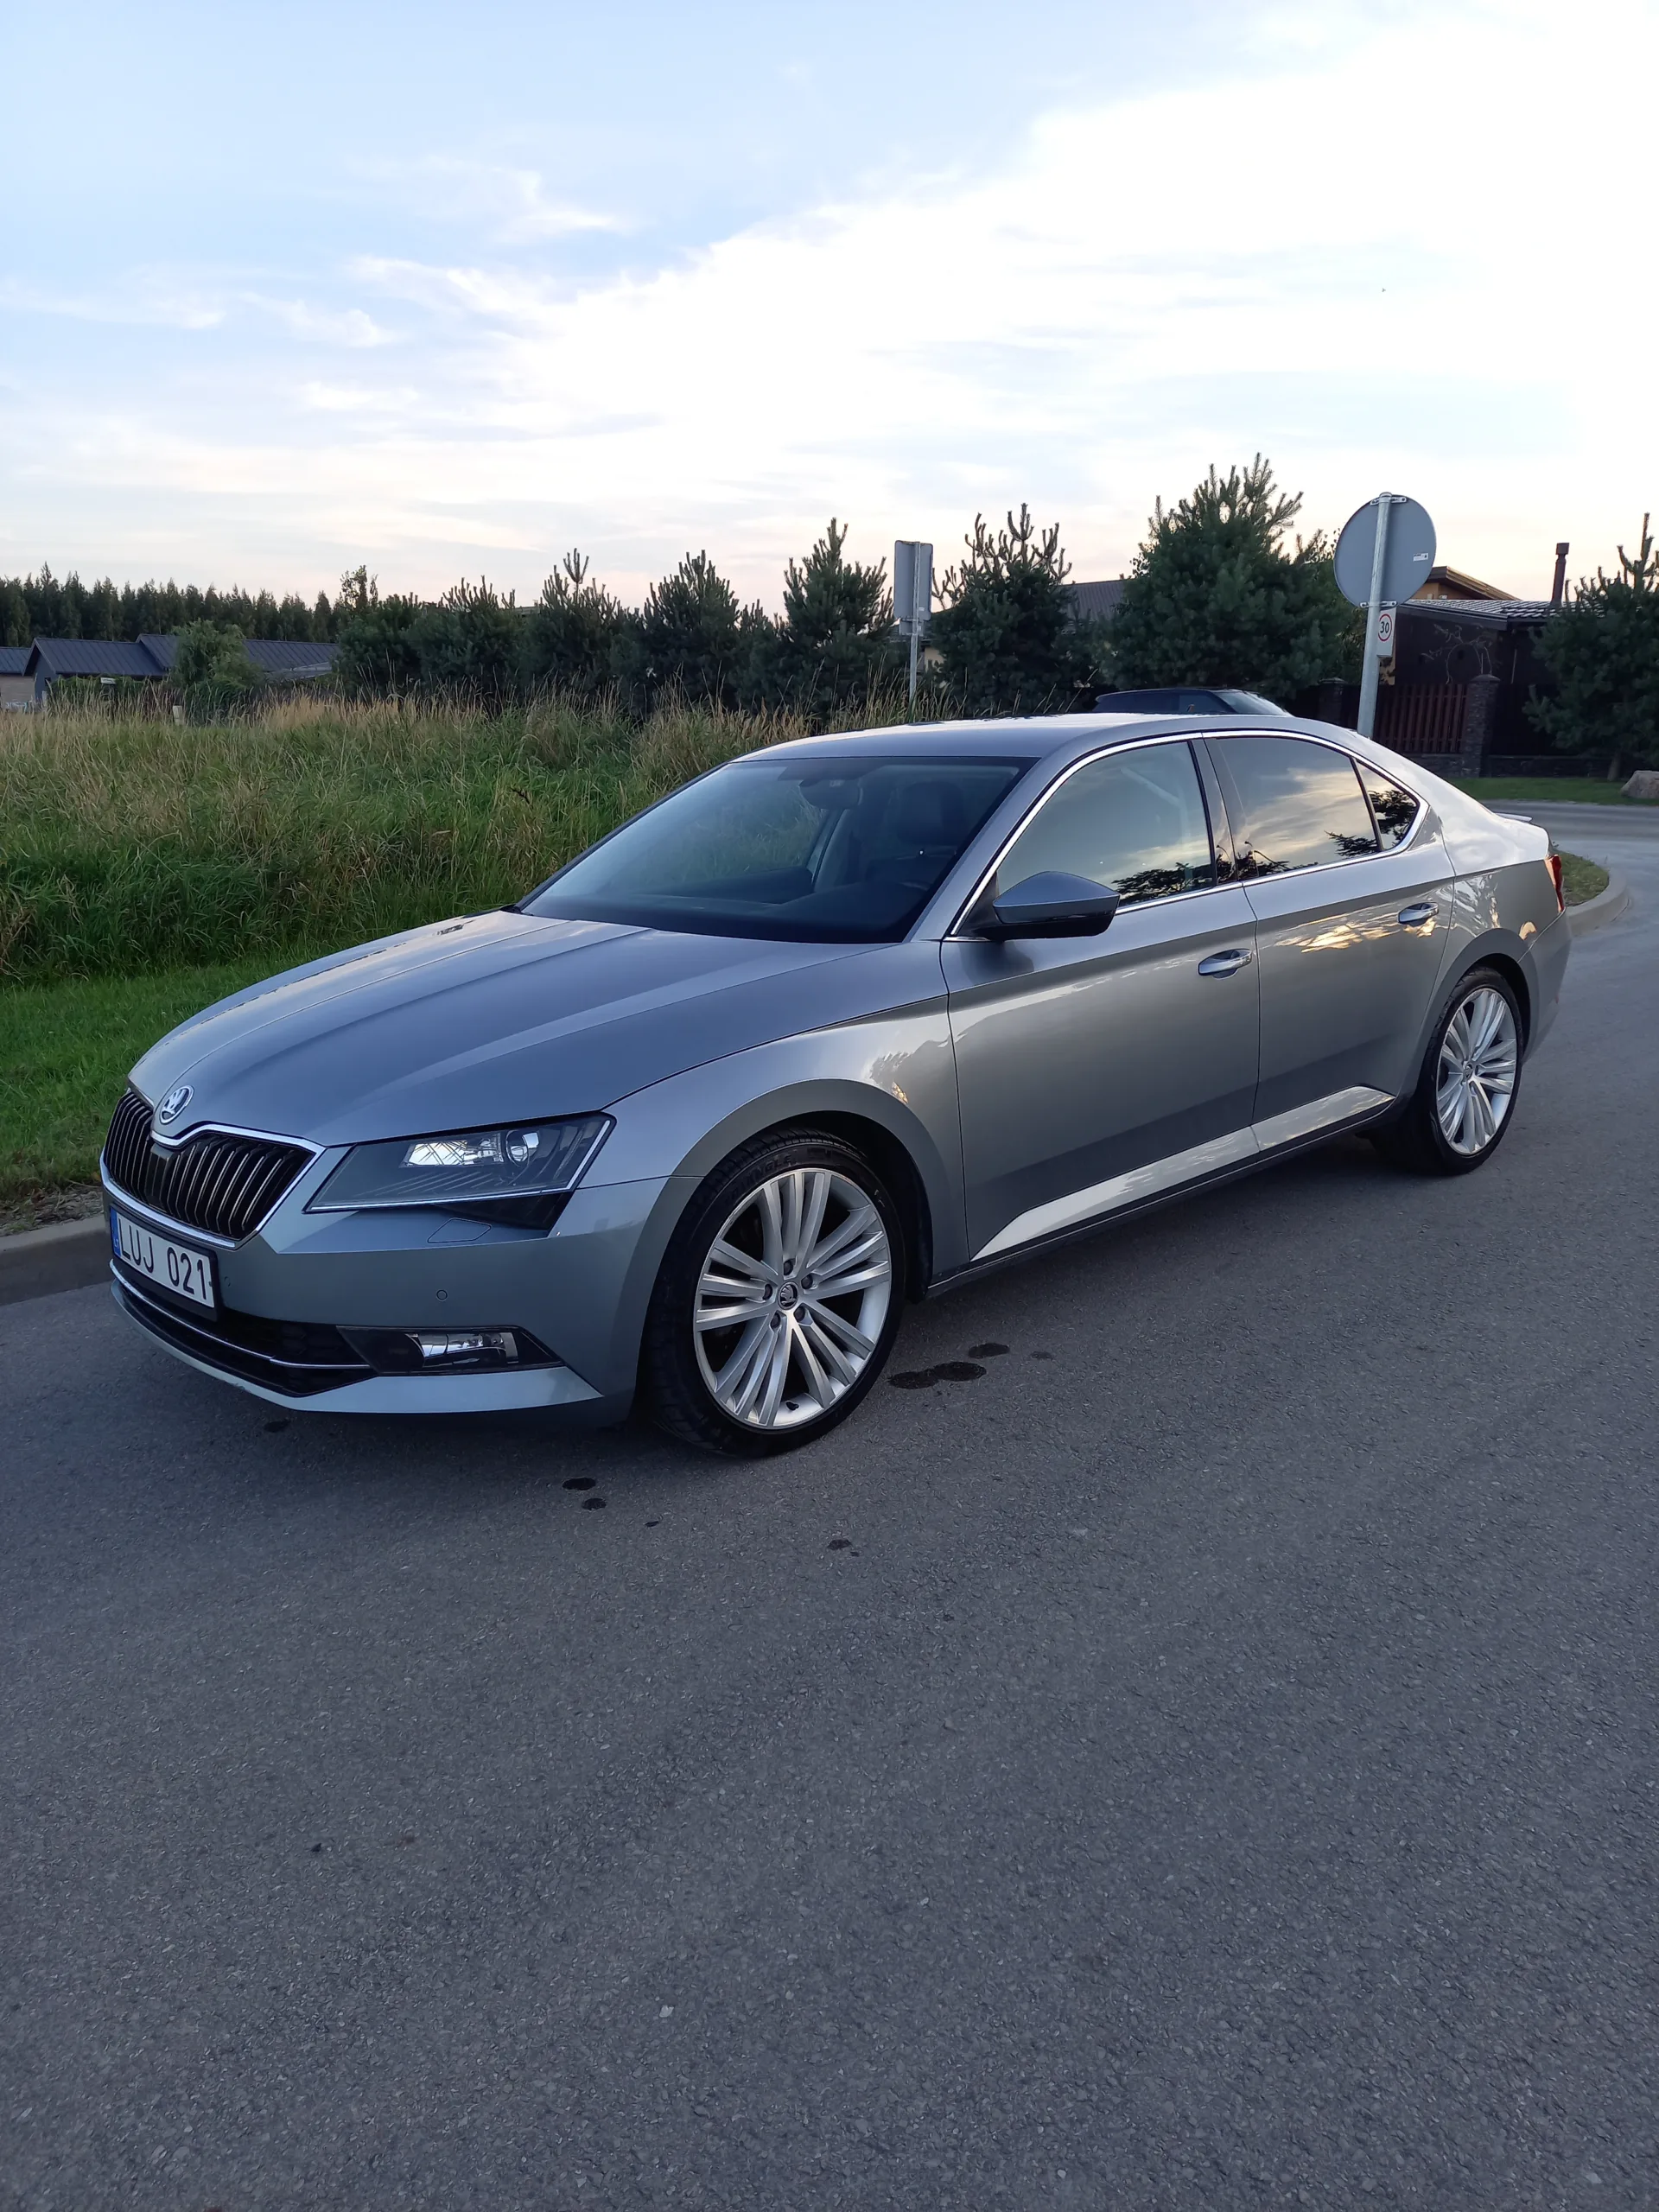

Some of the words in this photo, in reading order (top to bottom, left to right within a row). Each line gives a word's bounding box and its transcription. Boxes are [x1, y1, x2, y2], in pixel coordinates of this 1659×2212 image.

[1380, 621, 1389, 633] 30
[118, 1217, 154, 1274] LUJ
[167, 1247, 207, 1300] 021
